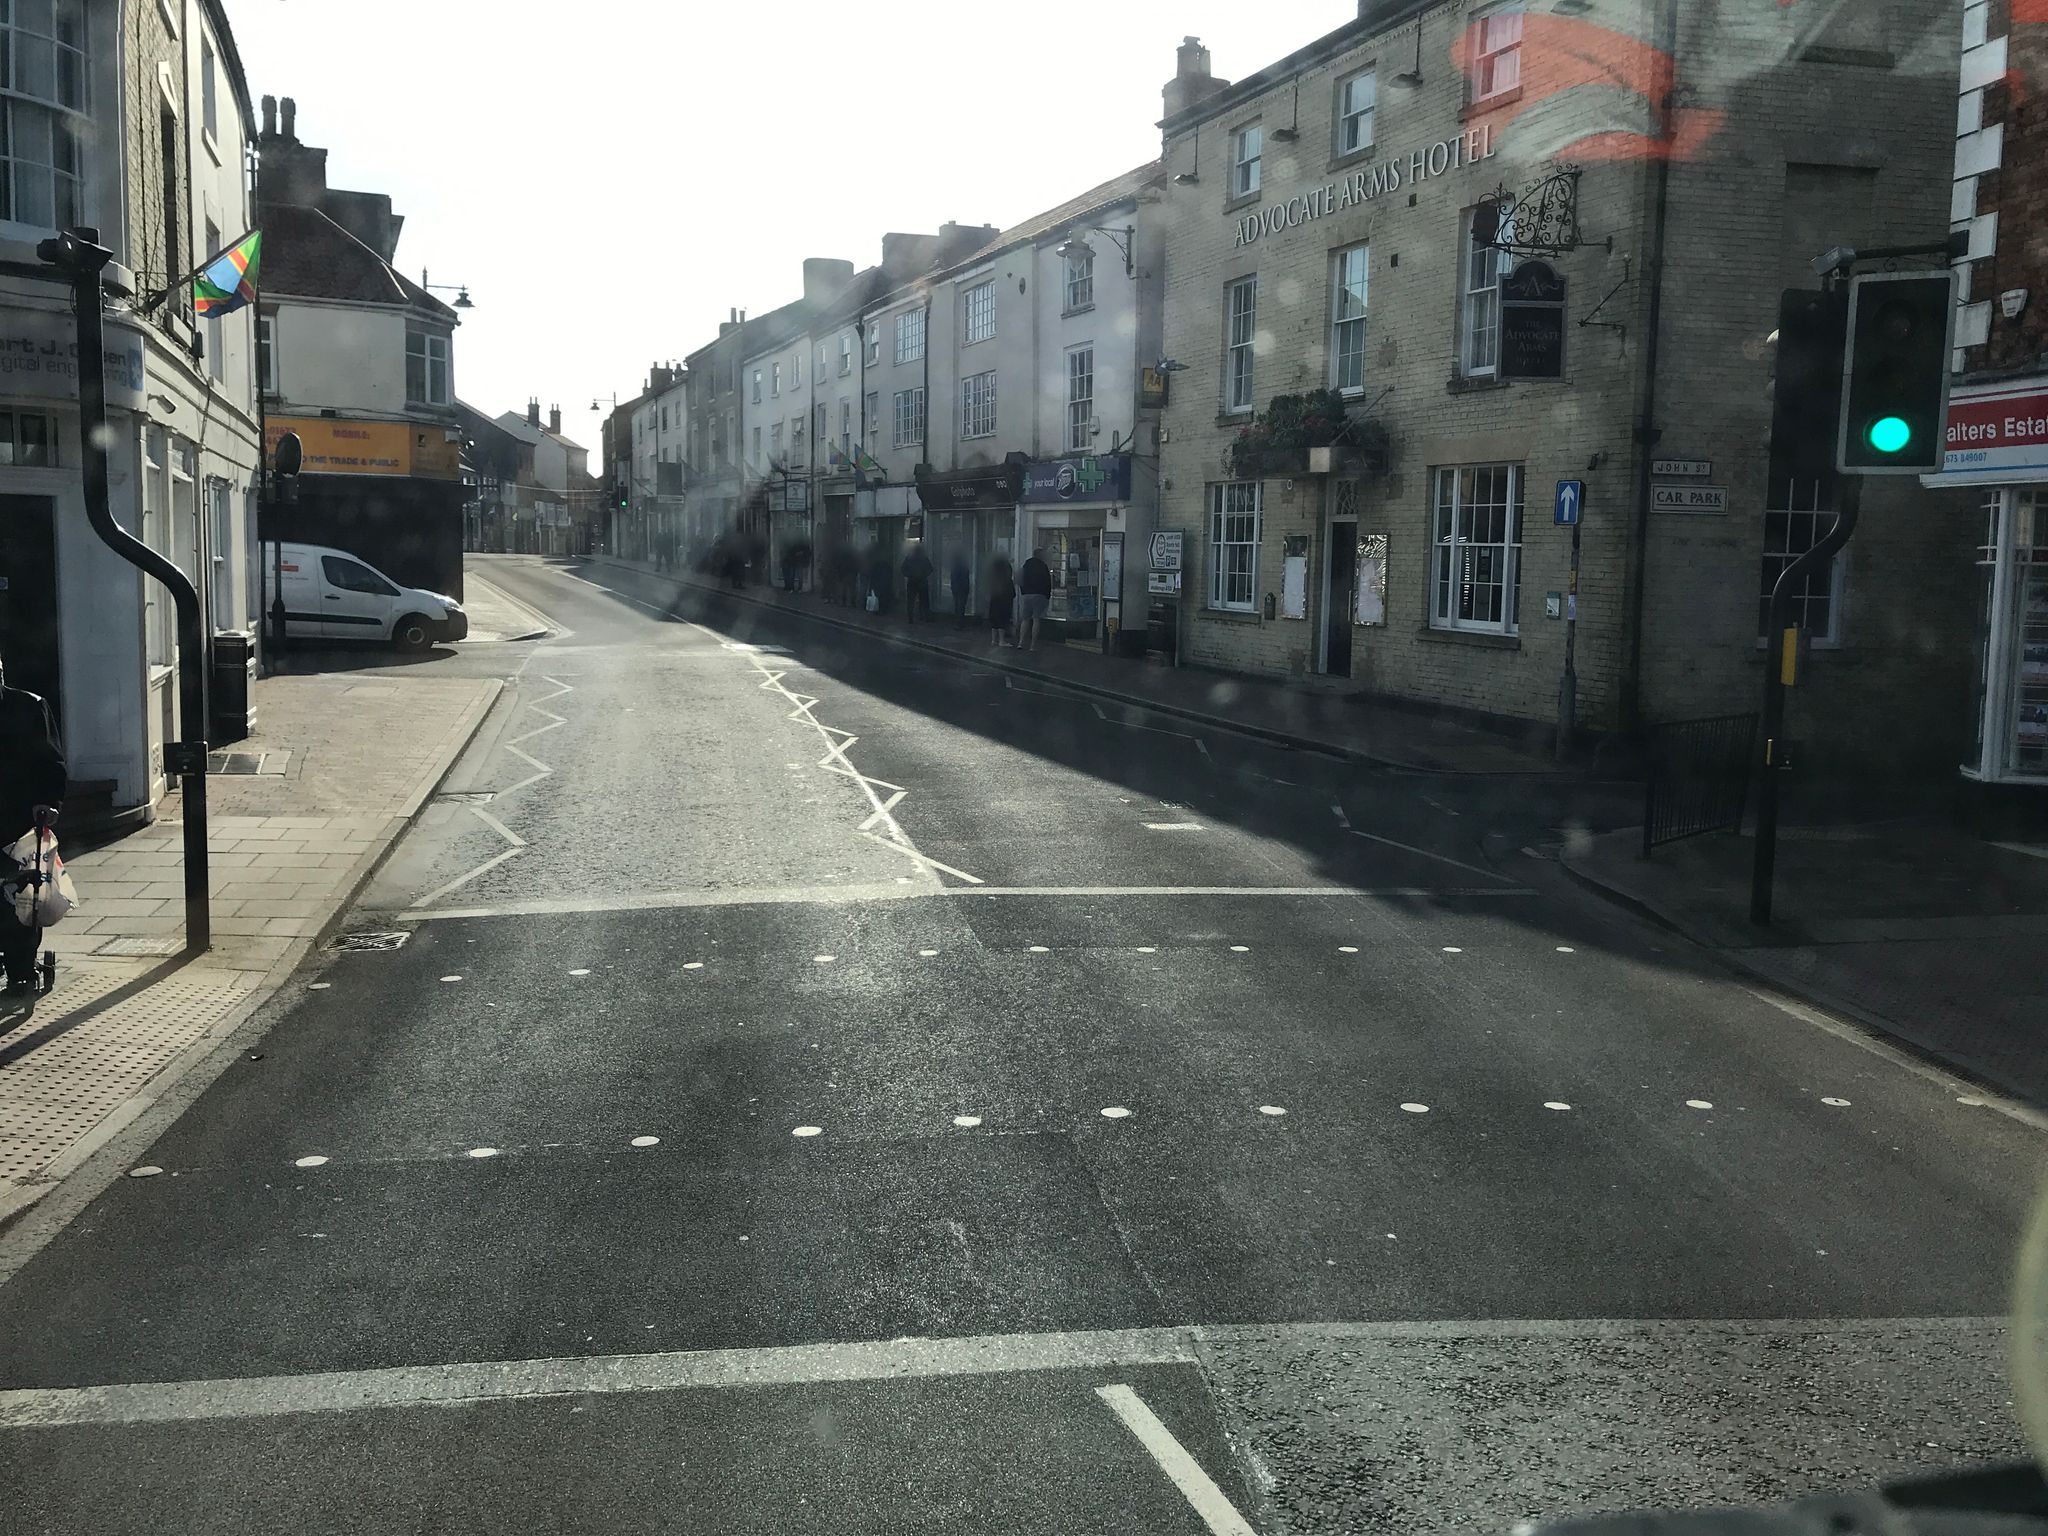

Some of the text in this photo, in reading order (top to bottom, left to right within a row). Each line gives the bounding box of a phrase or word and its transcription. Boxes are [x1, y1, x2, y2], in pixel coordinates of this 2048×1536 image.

[1235, 124, 1496, 248] ADVOCATE ARMS HOTEL
[1946, 416, 2048, 442] alters Esta
[329, 457, 359, 466] TRADE
[369, 459, 399, 467] PUBLIC
[1657, 464, 1688, 472] JOHN
[1044, 478, 1055, 488] local
[1656, 491, 1722, 504] CAR PARK
